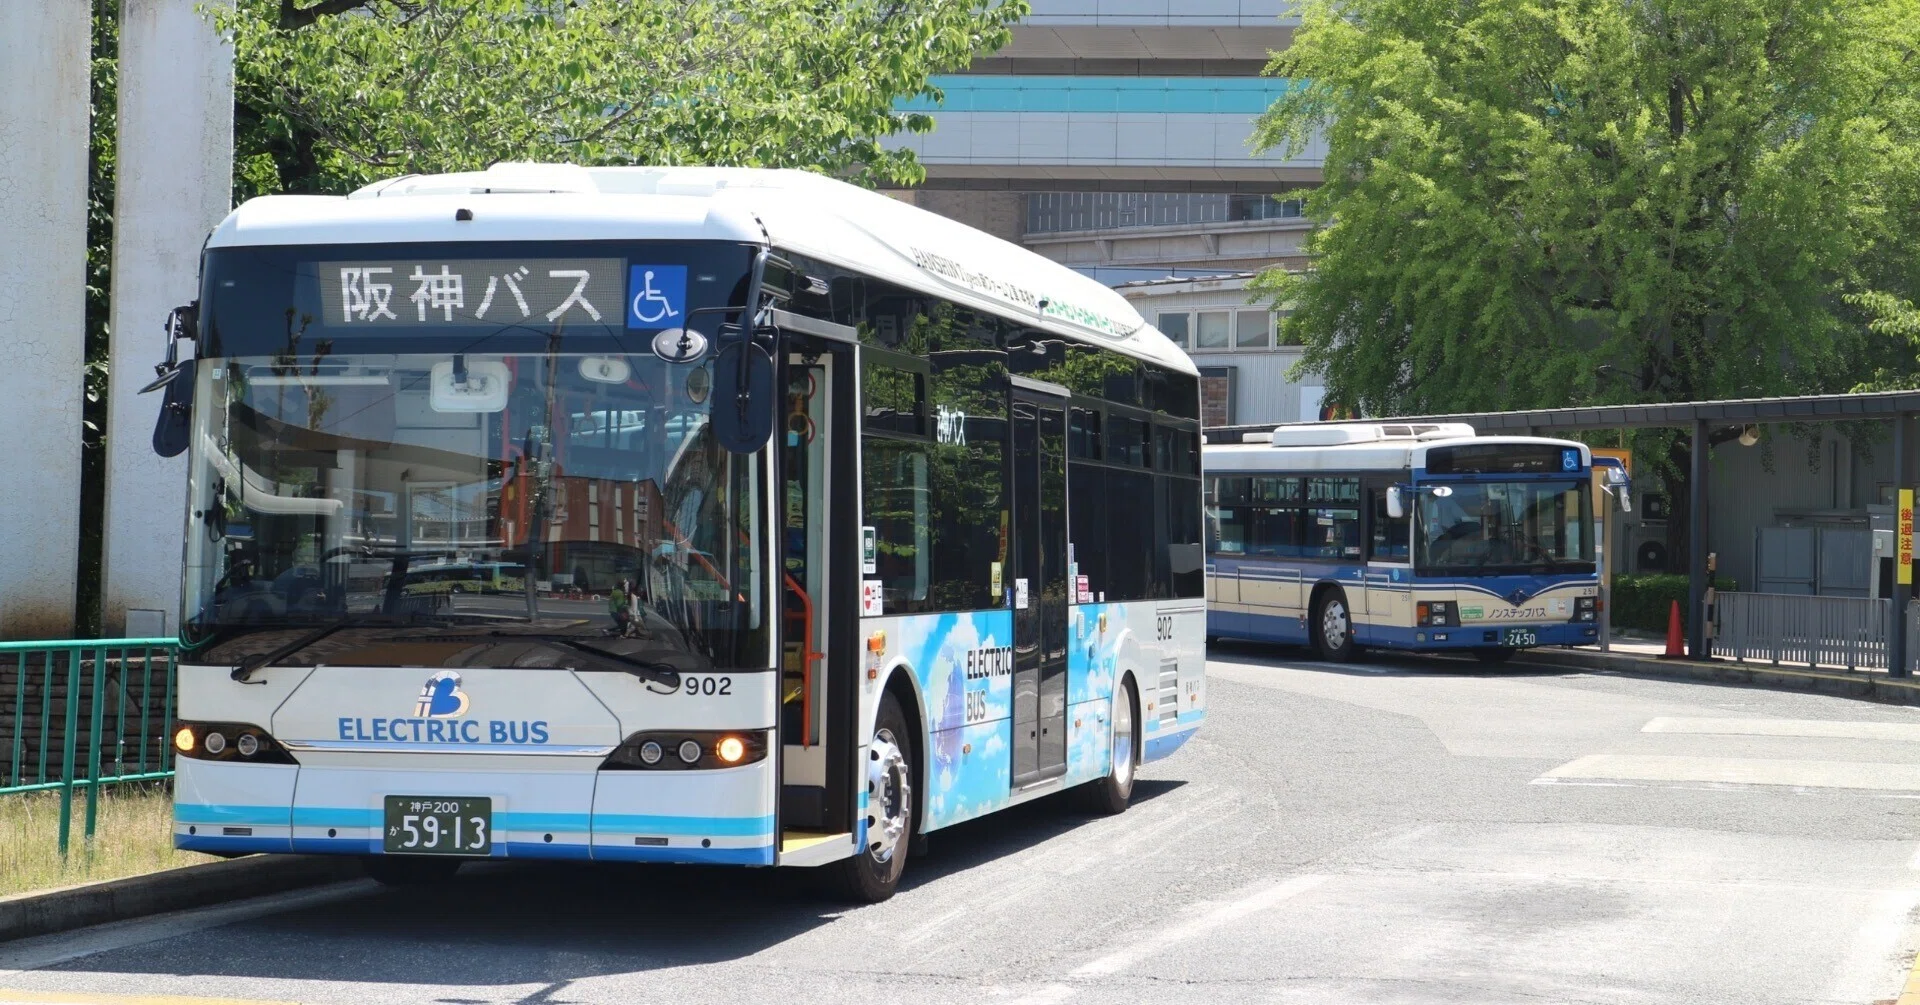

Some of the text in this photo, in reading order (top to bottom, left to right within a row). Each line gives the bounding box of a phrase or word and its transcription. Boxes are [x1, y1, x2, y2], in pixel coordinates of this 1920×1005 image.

[340, 265, 601, 322] 阪神バス
[1901, 508, 1912, 565] 後退注意
[1157, 616, 1172, 641] 902
[1488, 608, 1546, 619] ノンステップバス
[967, 646, 1012, 680] ELECTRIC
[685, 676, 732, 696] 902
[967, 690, 986, 721] BUS
[338, 717, 549, 744] ELECTRIC BUS
[389, 815, 486, 849] か 59-13
